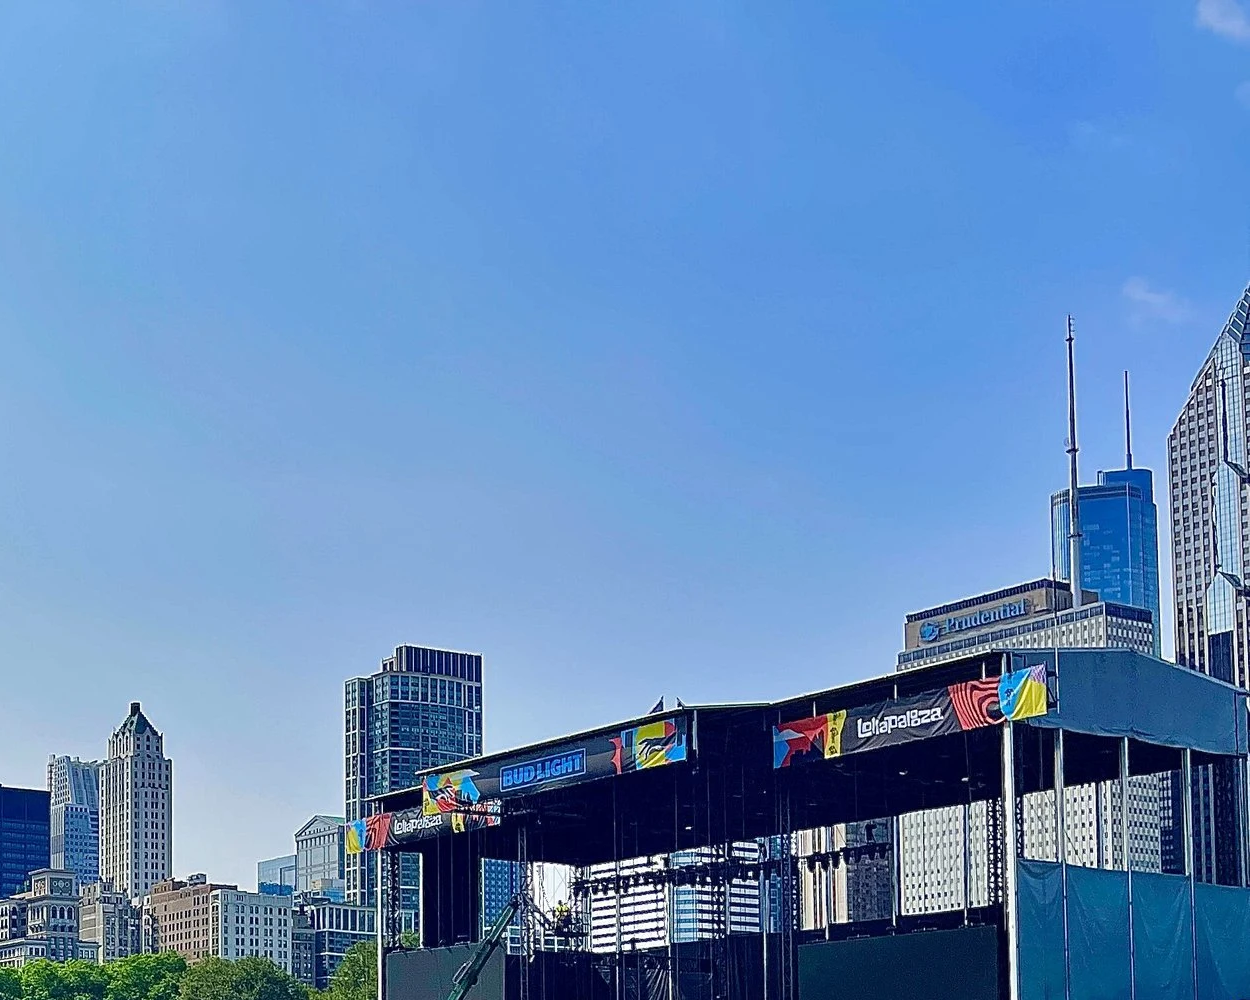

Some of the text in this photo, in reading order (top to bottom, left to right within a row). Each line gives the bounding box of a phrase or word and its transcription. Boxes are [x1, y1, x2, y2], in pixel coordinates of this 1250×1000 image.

[945, 599, 1026, 633] Prudential
[857, 707, 944, 738] Lollapalooza
[502, 753, 583, 787] BUD LIGHT
